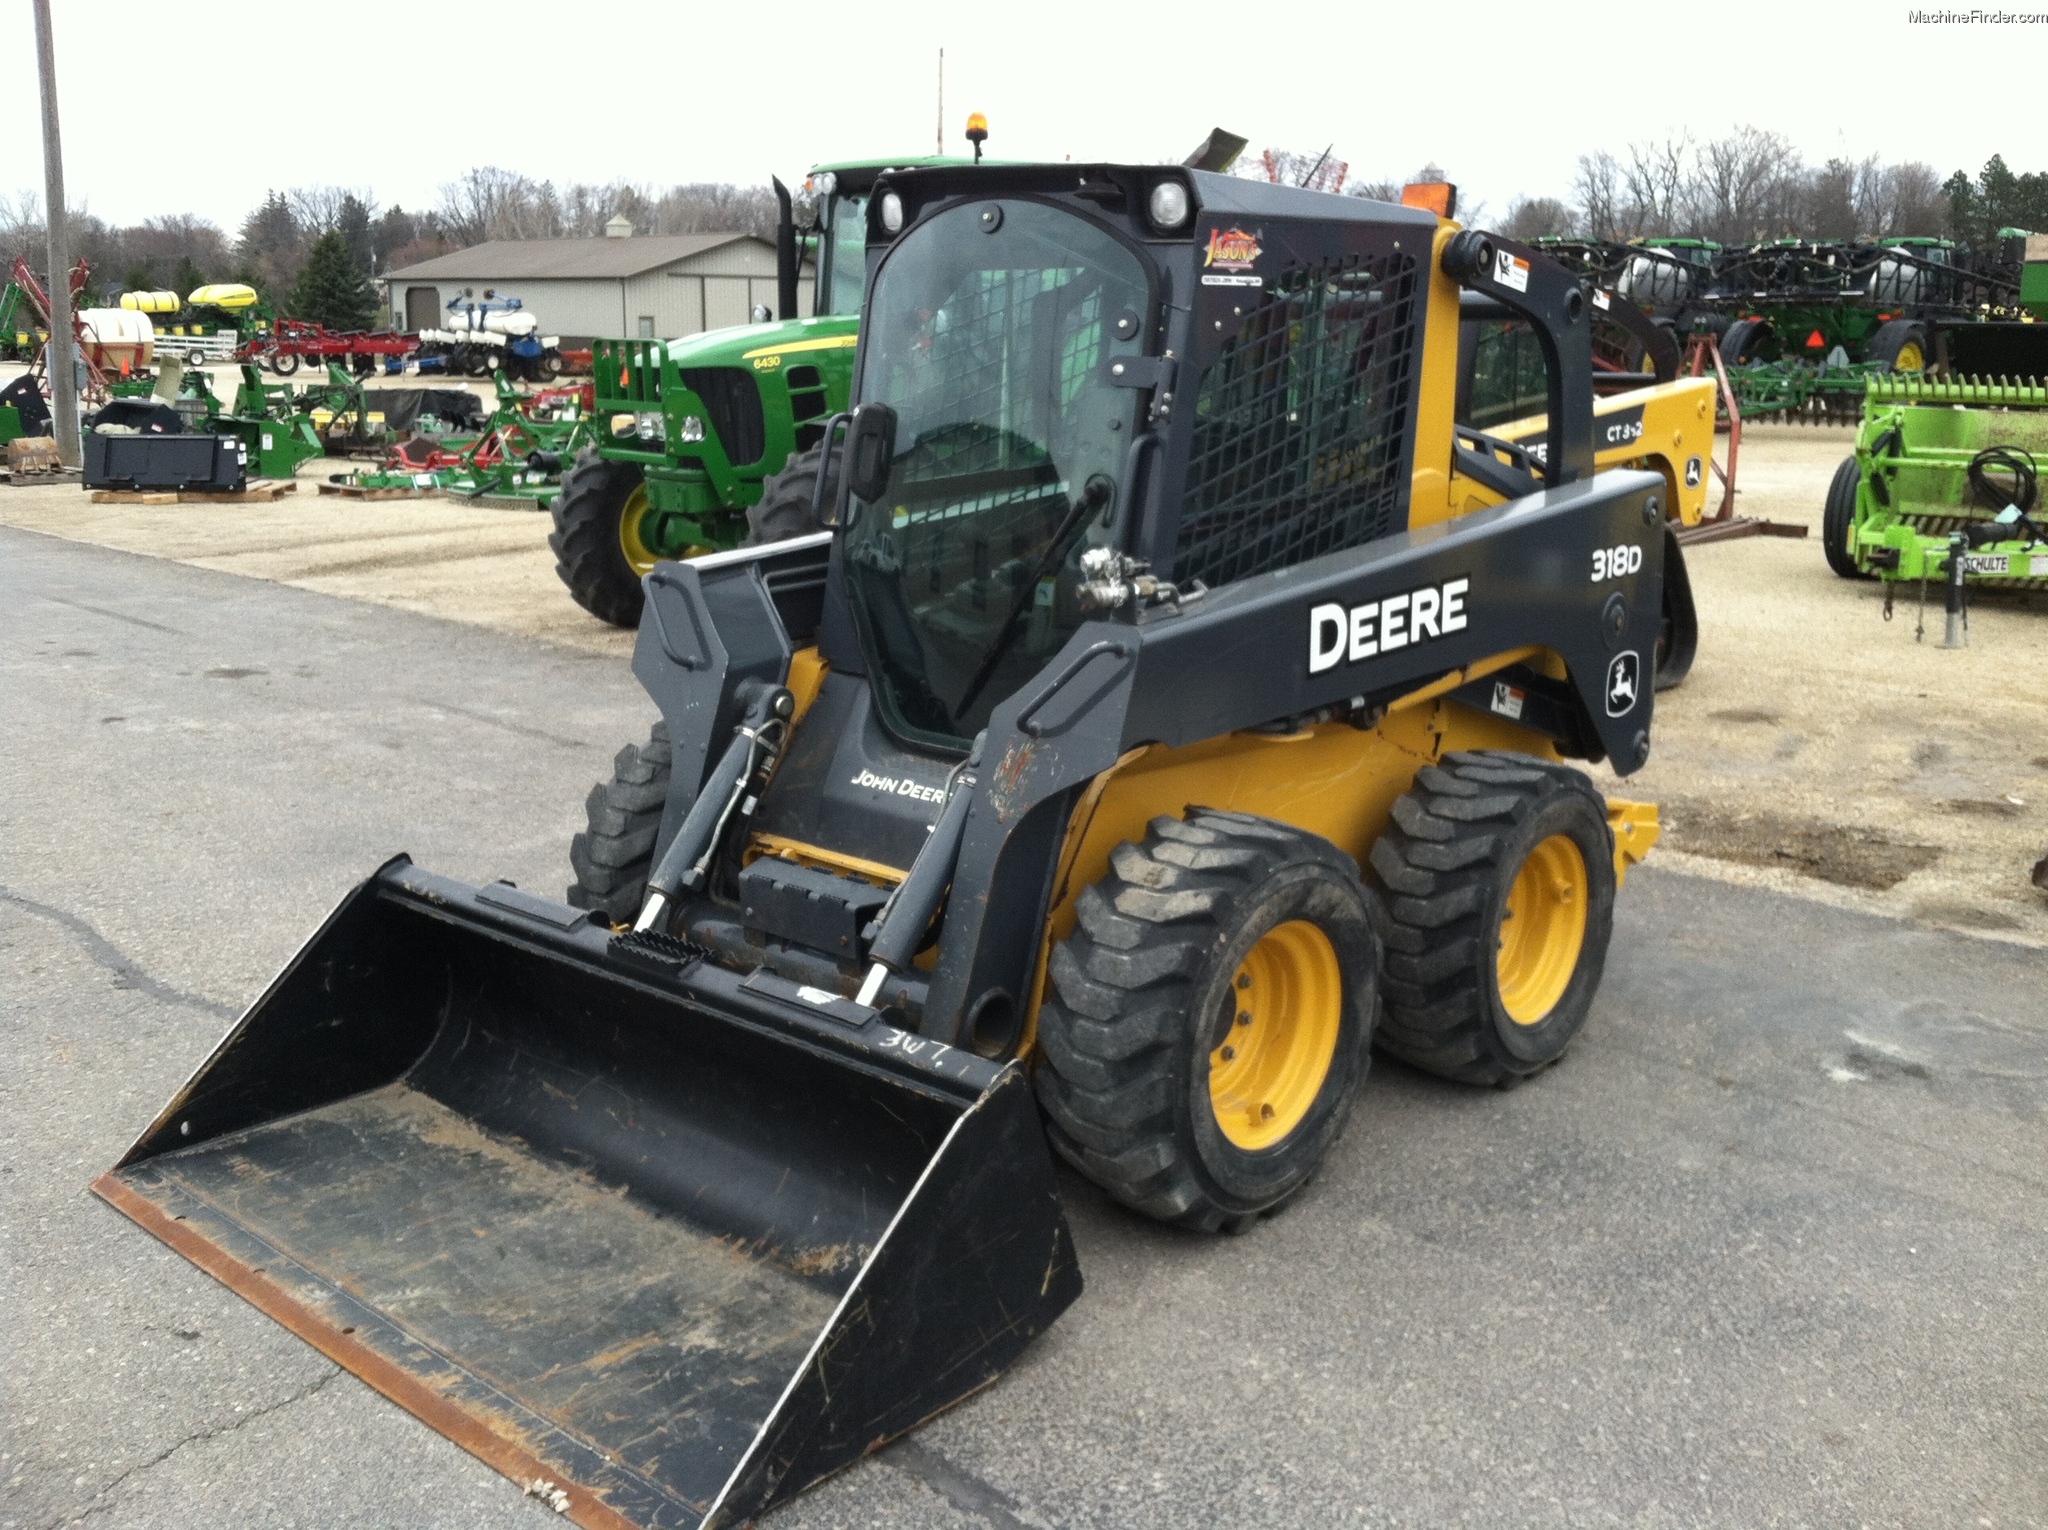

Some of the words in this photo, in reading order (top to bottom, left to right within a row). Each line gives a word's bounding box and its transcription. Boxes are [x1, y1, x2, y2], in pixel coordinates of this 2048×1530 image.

[753, 355, 780, 369] 6430
[1591, 545, 1642, 582] 318D
[1309, 578, 1469, 674] DEERE
[851, 769, 899, 794] JOHN
[897, 779, 953, 804] DEER
